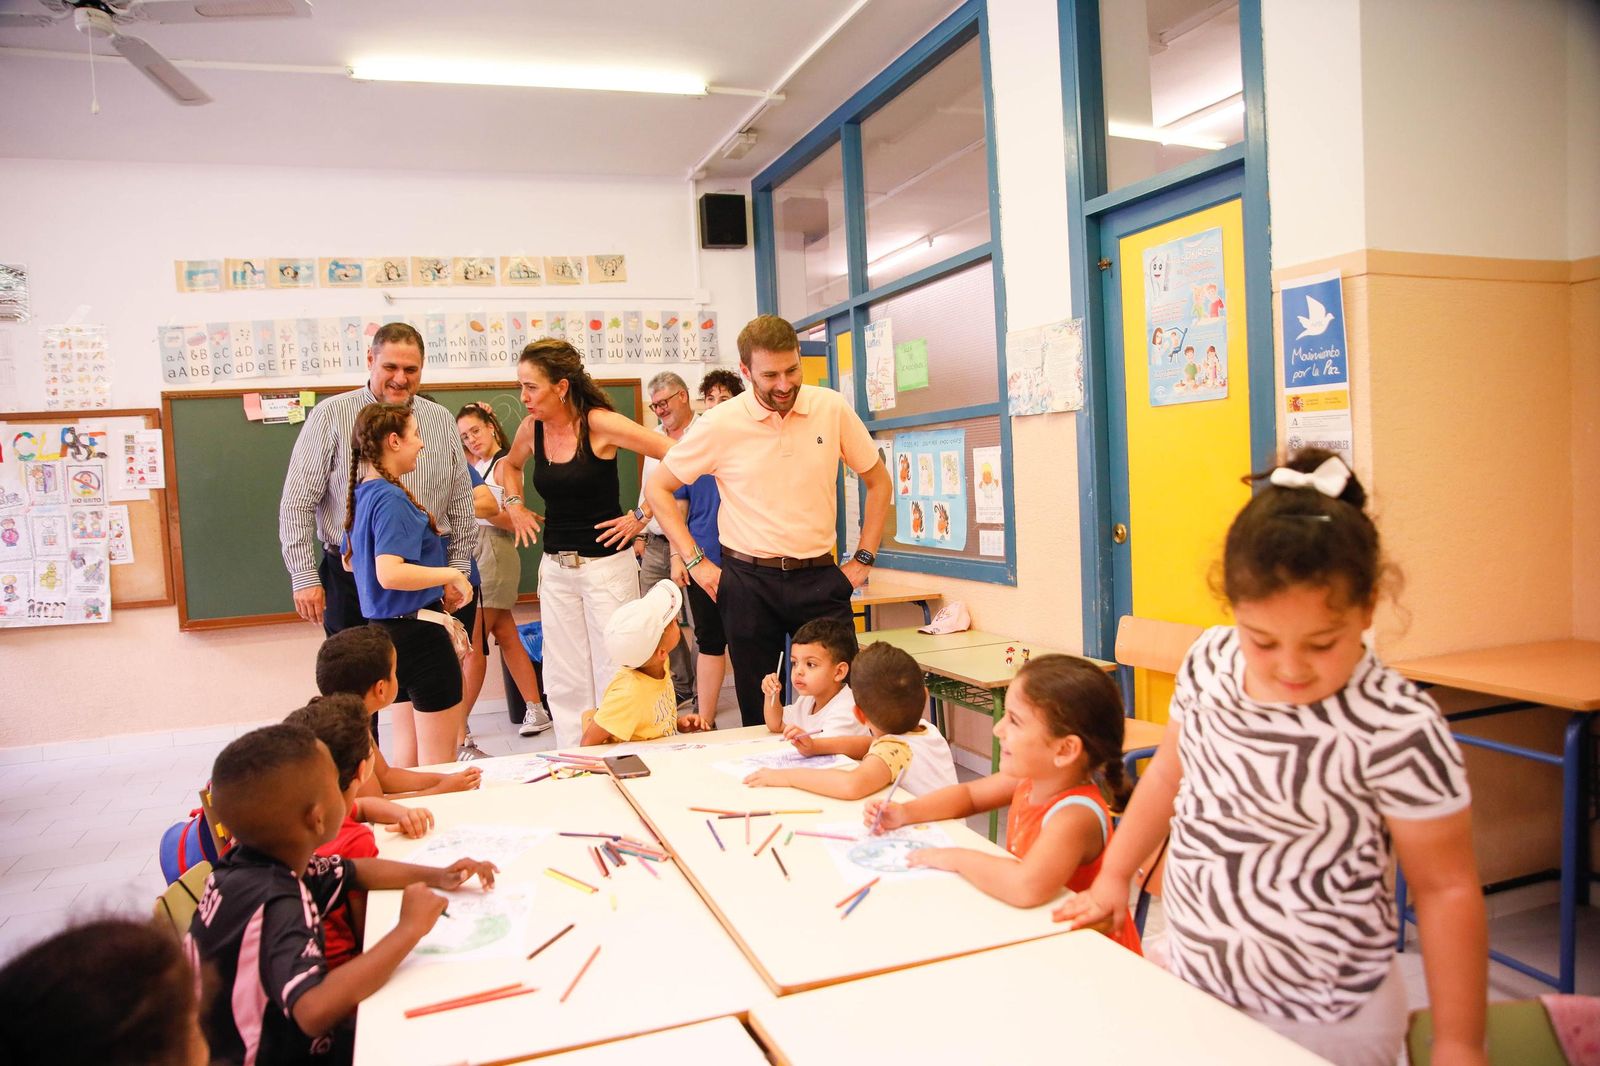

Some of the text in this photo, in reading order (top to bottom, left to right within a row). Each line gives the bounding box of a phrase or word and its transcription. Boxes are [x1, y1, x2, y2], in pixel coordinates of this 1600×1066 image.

[1291, 344, 1340, 365] Movimiento
[1292, 359, 1341, 383] por la Paz
[12, 427, 108, 462] CLASE
